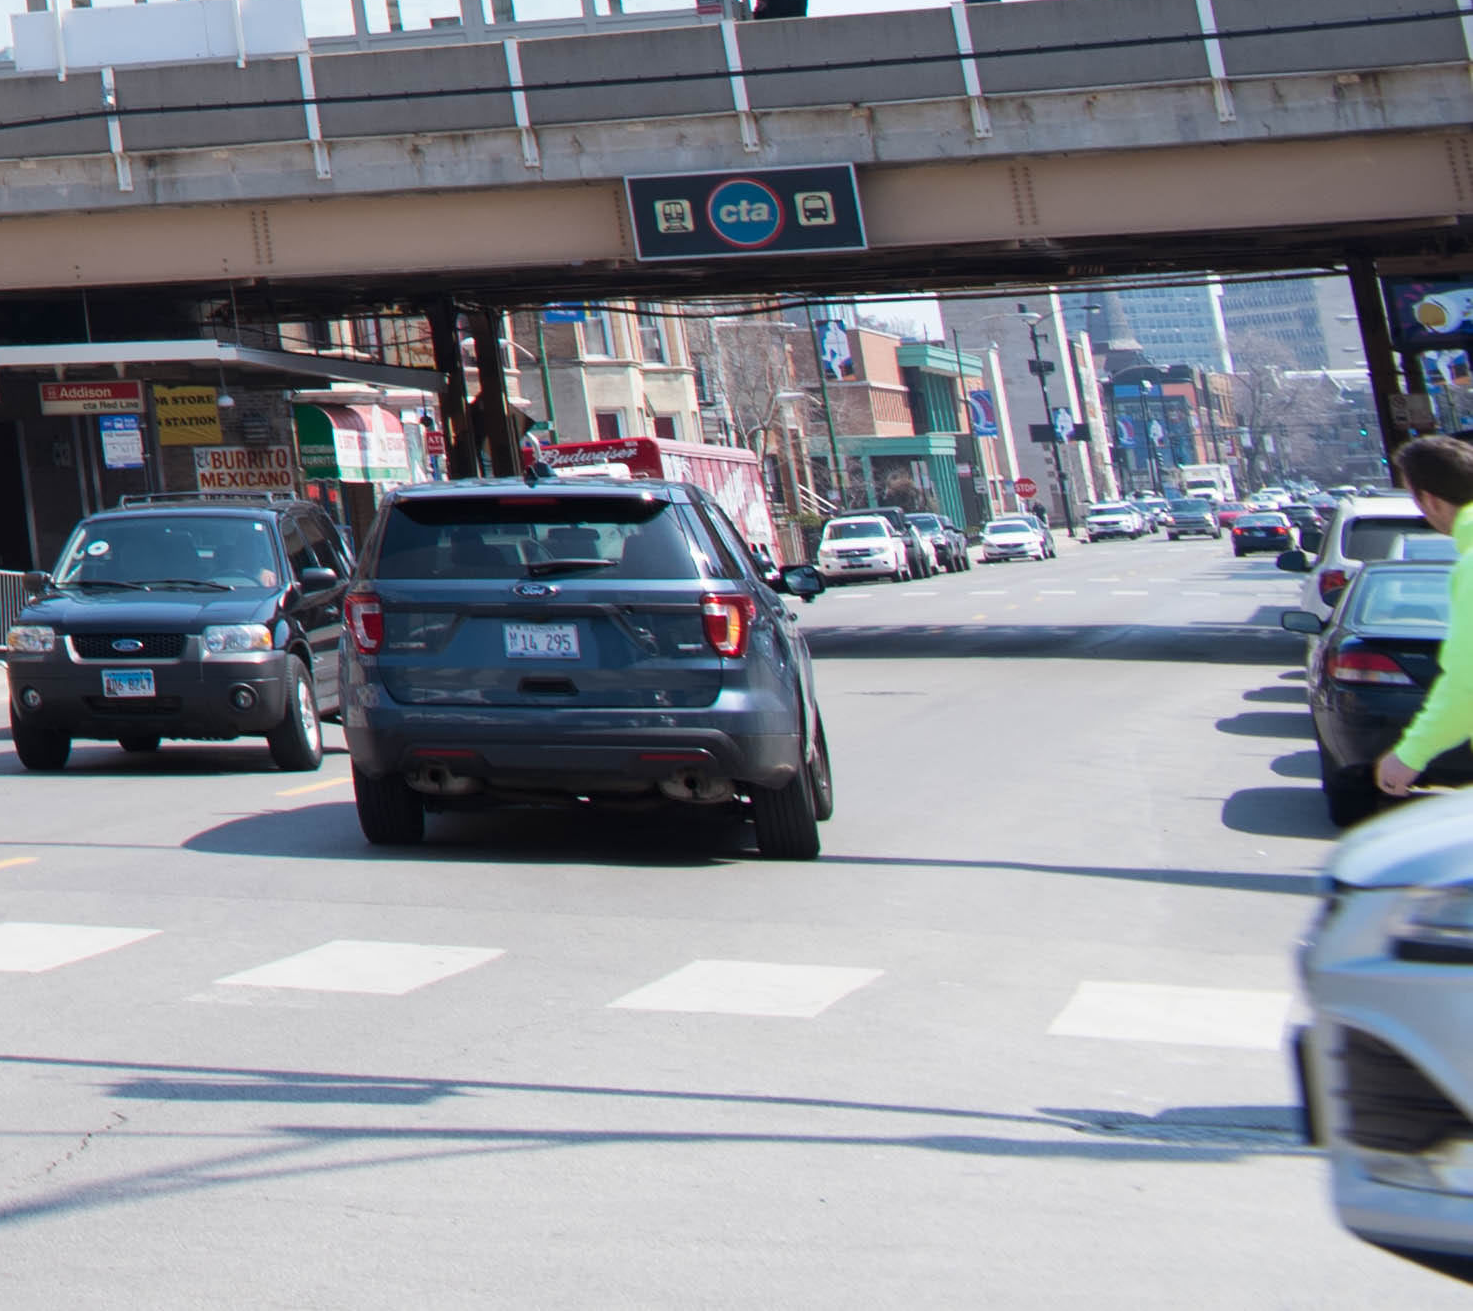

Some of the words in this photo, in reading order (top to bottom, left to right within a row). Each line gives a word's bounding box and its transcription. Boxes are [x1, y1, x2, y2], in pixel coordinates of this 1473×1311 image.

[719, 199, 770, 224] cta
[59, 386, 112, 399] Addison
[171, 394, 214, 406] STORE
[83, 400, 98, 410] cta
[99, 400, 118, 410] Red
[120, 400, 139, 409] Line
[164, 416, 218, 427] STATION
[211, 448, 287, 470] BURRITO
[540, 445, 639, 467] Budweiser
[200, 470, 291, 489] MEXICANO
[1014, 483, 1036, 493] STOP
[521, 633, 537, 652] 14
[546, 633, 572, 651] 295
